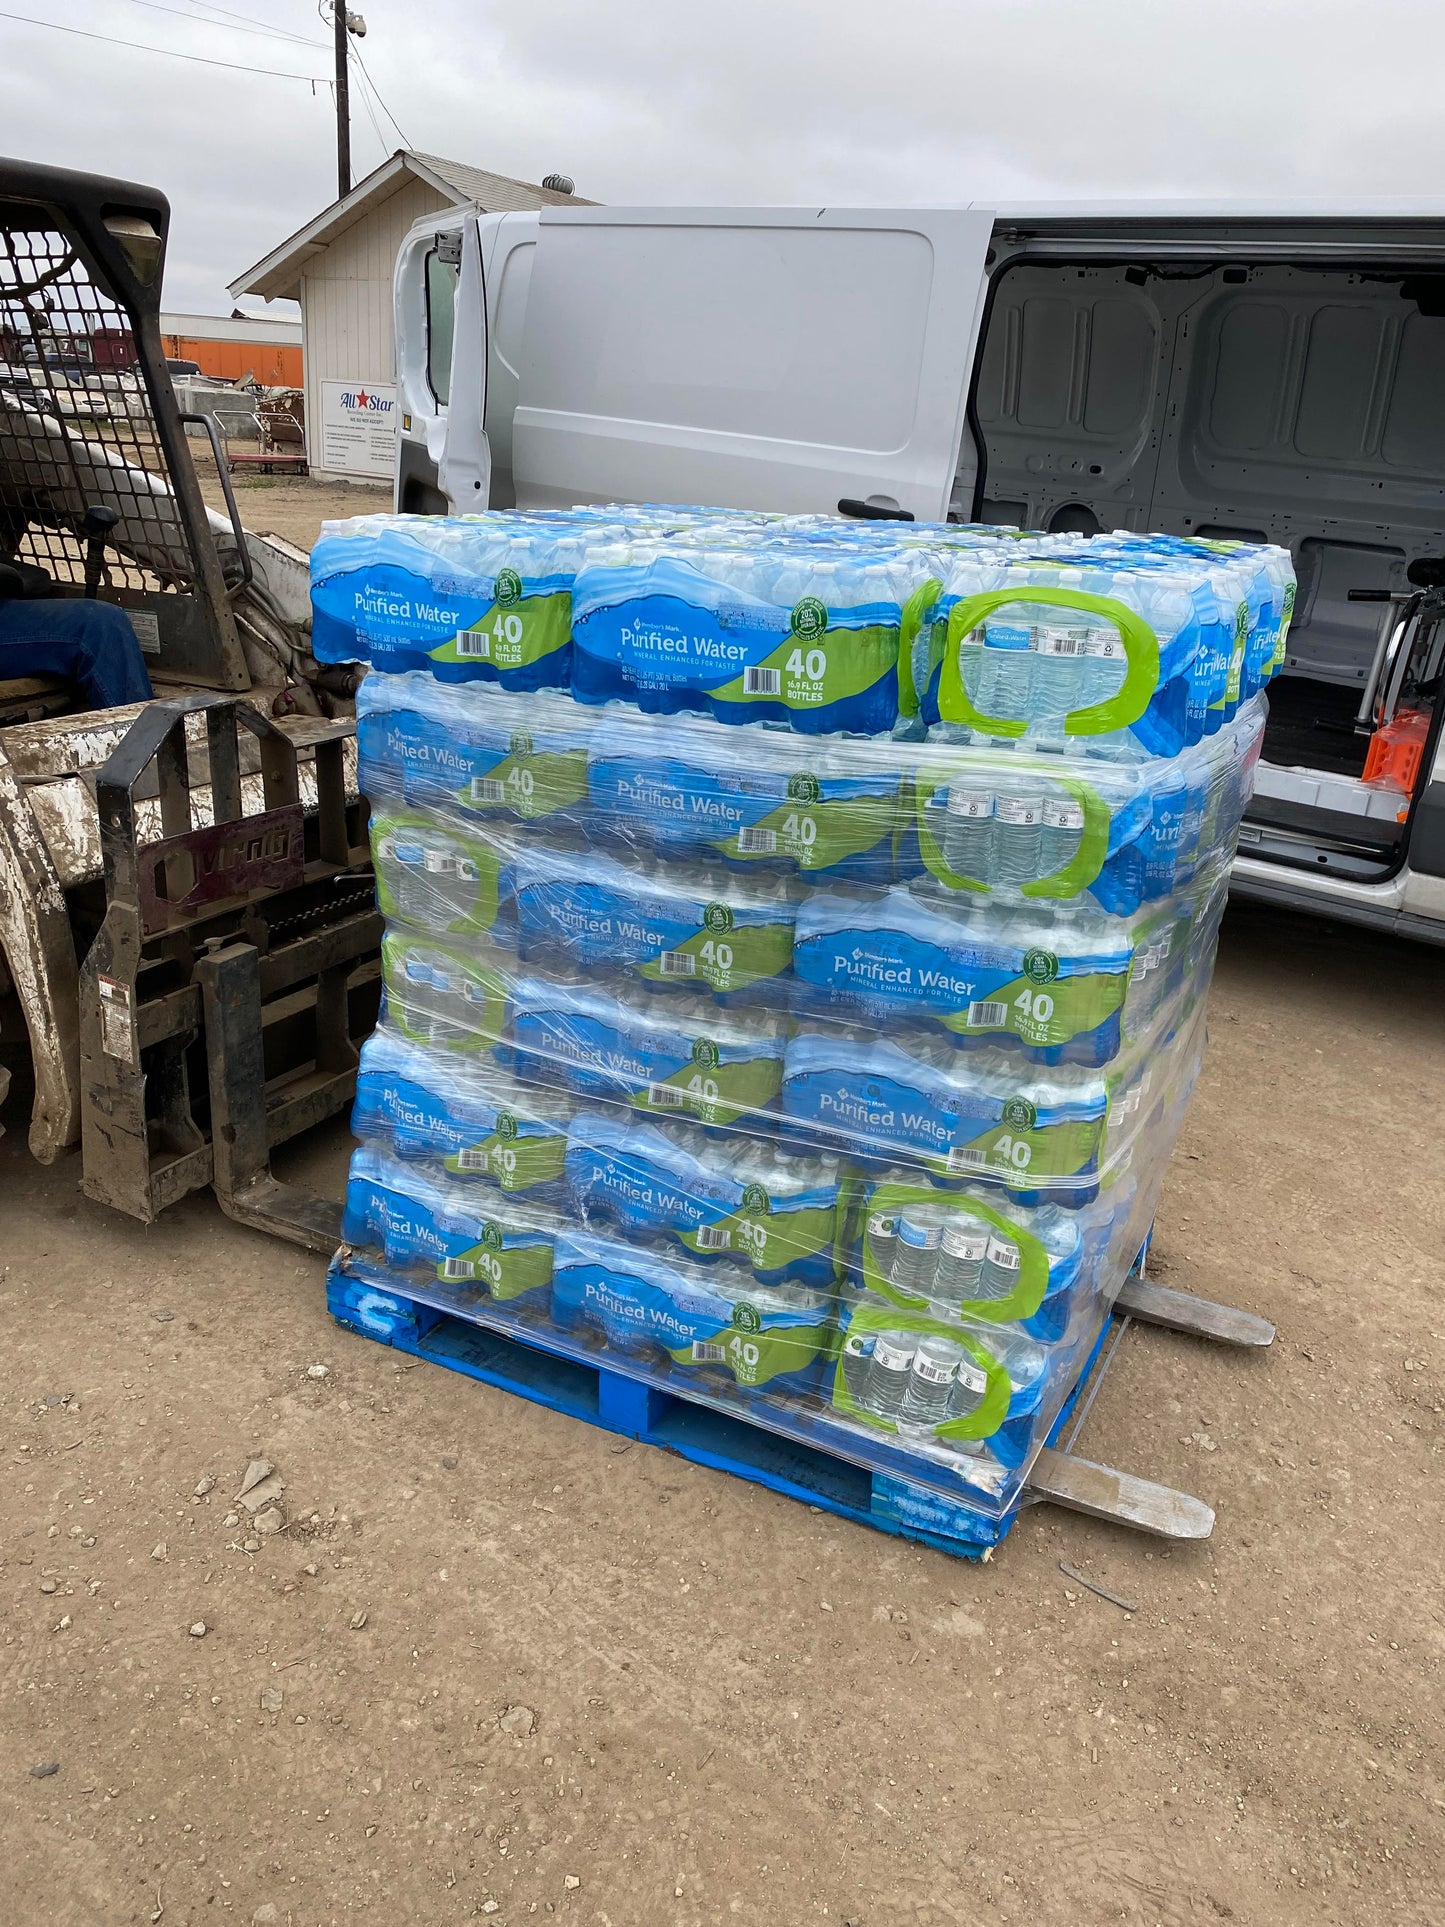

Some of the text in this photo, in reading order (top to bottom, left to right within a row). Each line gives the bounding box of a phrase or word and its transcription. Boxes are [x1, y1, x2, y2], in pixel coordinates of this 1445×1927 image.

[340, 392, 394, 411] All Star
[355, 593, 459, 625] Purified Water
[386, 618, 421, 628] ENHANCED
[431, 625, 449, 633] TASTE
[493, 614, 523, 644] 40
[664, 624, 681, 632] Mark
[503, 644, 522, 653] FL OZ
[621, 628, 748, 661] Purified Water
[659, 654, 700, 665] ENHANCED
[701, 659, 713, 667] FOR
[715, 661, 736, 671] TASTE
[785, 648, 826, 681] 40
[1213, 652, 1231, 671] Wat
[787, 680, 823, 691] 16.9 FL OZ
[787, 690, 823, 701] BOTTLES
[431, 747, 474, 772] Water
[508, 766, 533, 796] 40
[617, 779, 684, 810] Purified
[691, 795, 743, 821] Water
[782, 814, 817, 846] 40
[549, 903, 665, 946] Purified Water
[700, 940, 733, 970] 40
[713, 968, 720, 977] FL
[721, 971, 731, 979] OZ
[834, 955, 976, 996] Purified Water
[850, 976, 878, 989] MINERAL
[880, 984, 924, 995] ENHANCED
[926, 988, 941, 997] FOR
[1014, 988, 1054, 1022] 40
[1014, 1021, 1048, 1042] BOTTLES
[1027, 1021, 1037, 1030] FL
[1037, 1023, 1049, 1032] OZ
[541, 1032, 654, 1079] Purified Water
[687, 1074, 719, 1102] 40
[428, 1115, 464, 1144] Water
[820, 1093, 956, 1142] Purified Water
[865, 1126, 907, 1136] ENHANCED
[491, 1143, 517, 1172] 40
[993, 1134, 1032, 1168] 40
[592, 1166, 652, 1204] Purified
[657, 1191, 704, 1220] Water
[628, 1200, 663, 1216] ENHANCED
[371, 1194, 449, 1253] Puied Water
[735, 1218, 768, 1249] 40
[478, 1253, 502, 1281] 40
[585, 1283, 645, 1321] Purified
[649, 1307, 697, 1337] Water
[729, 1335, 759, 1366] 40
[748, 1366, 757, 1375] OZ
